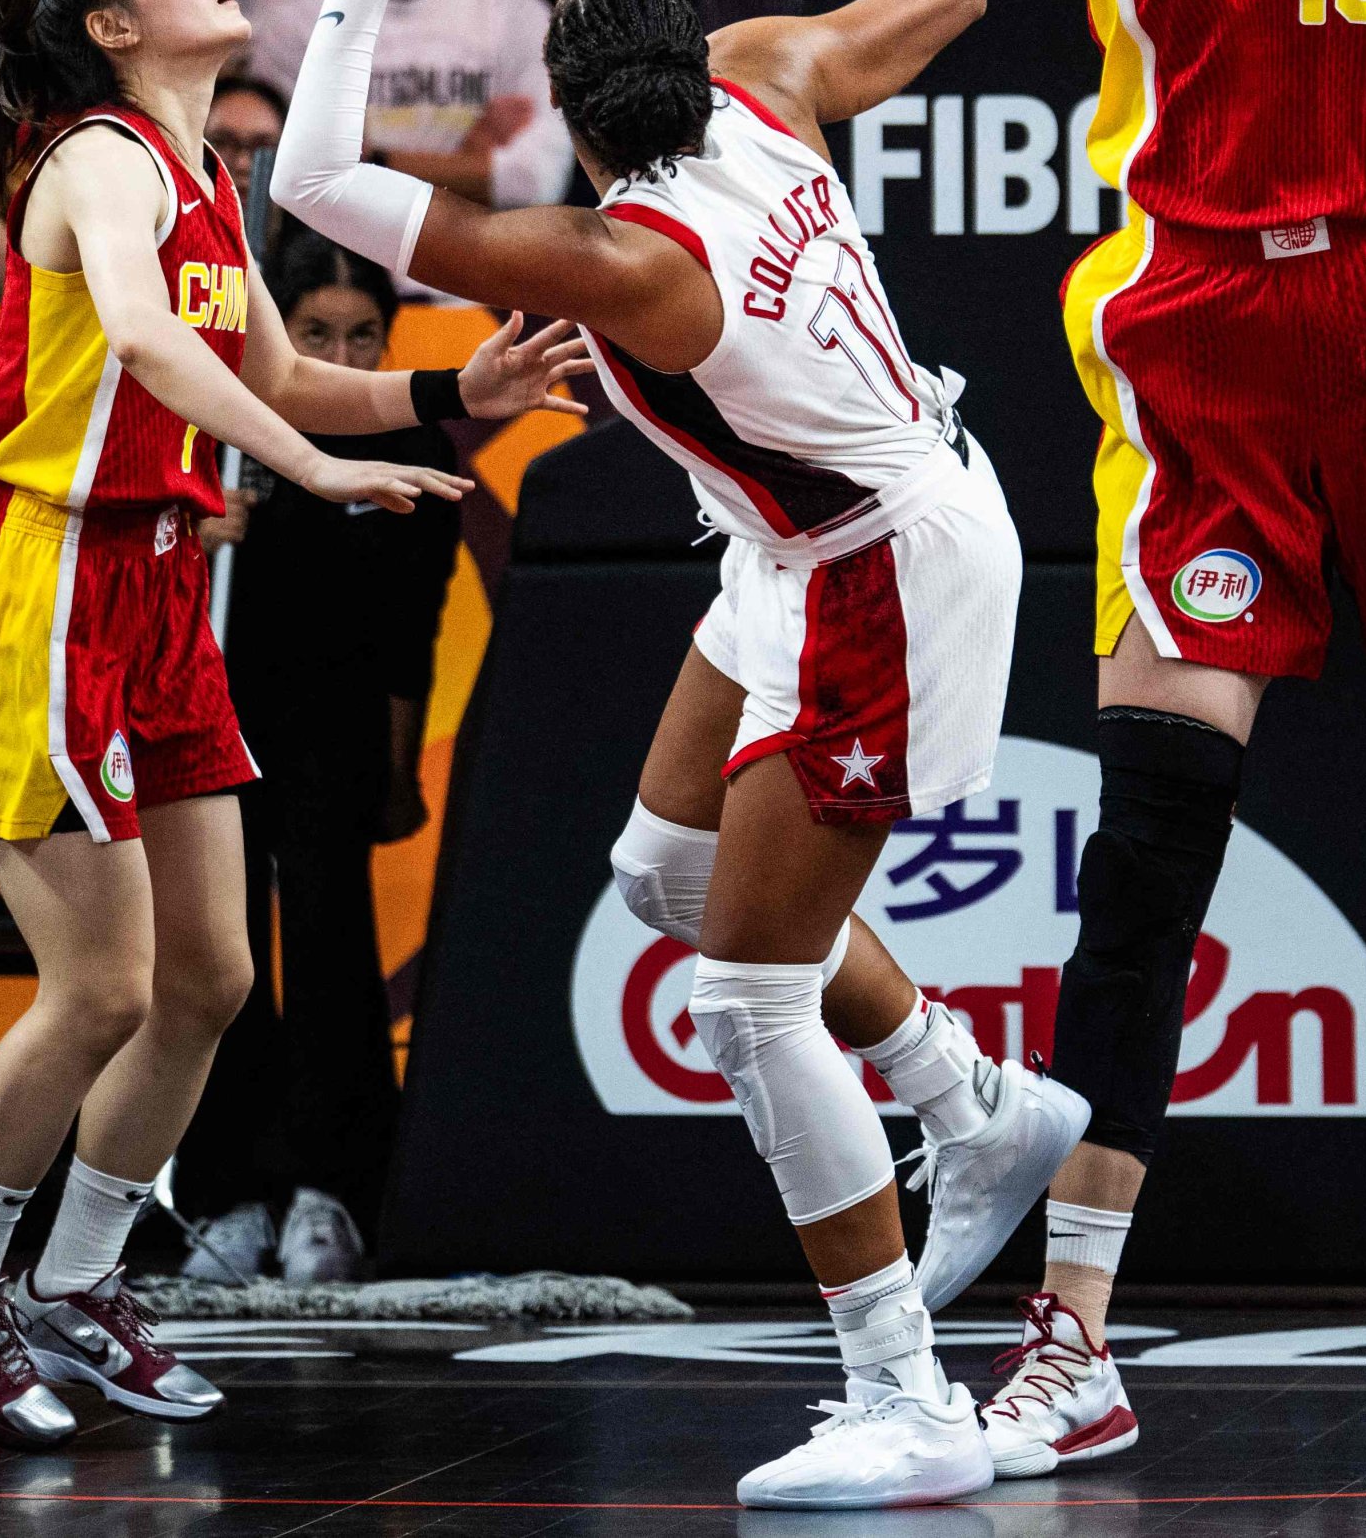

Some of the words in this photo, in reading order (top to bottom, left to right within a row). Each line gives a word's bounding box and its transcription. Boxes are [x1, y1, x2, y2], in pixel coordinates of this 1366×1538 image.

[743, 174, 839, 322] COLLIER
[178, 261, 248, 334] CHIN
[1187, 568, 1249, 602] 伊利
